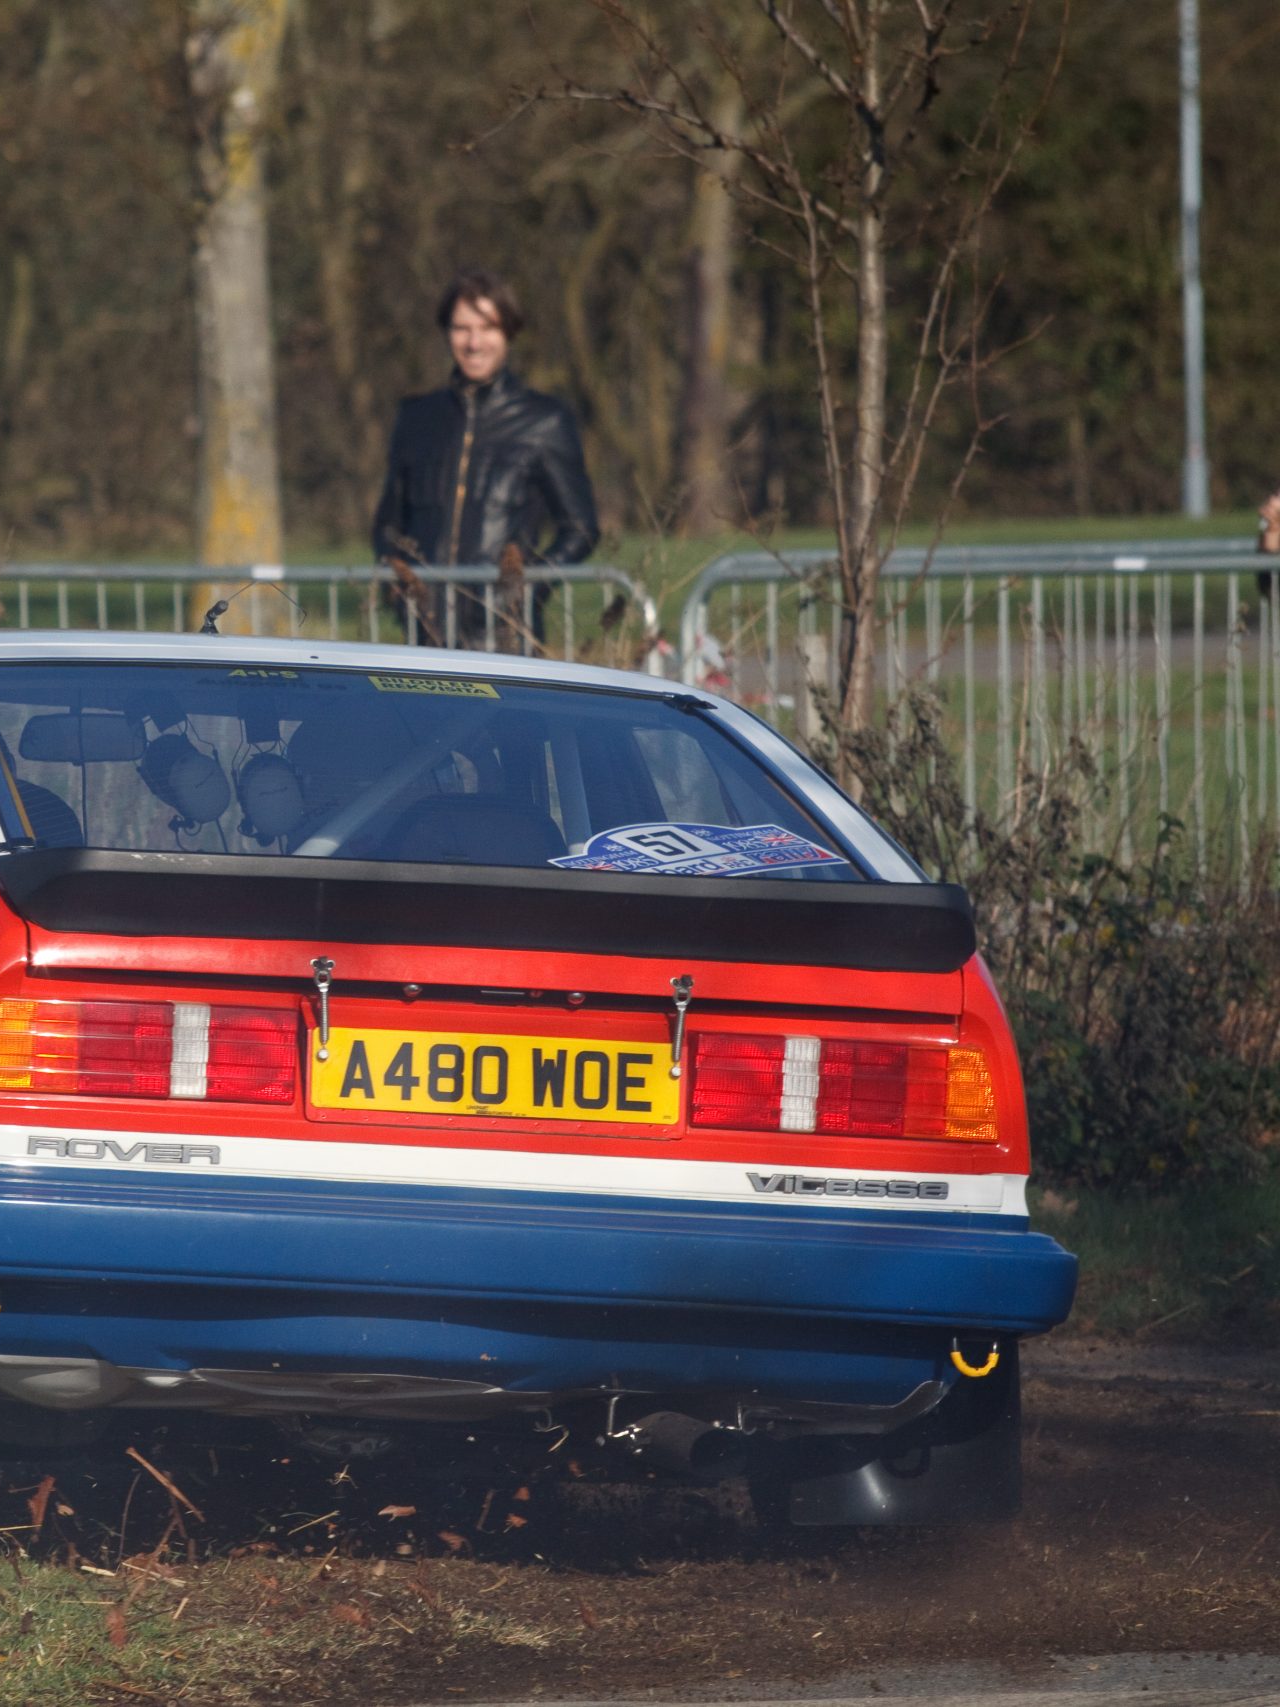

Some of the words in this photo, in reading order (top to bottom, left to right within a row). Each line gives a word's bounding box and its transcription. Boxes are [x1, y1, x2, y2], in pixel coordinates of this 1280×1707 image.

[377, 677, 476, 688] BILDELER
[381, 683, 489, 695] REKVISITA
[625, 830, 703, 856] 57
[611, 855, 660, 871] 1985
[339, 1039, 508, 1105] A480
[532, 1047, 654, 1112] WOE
[27, 1135, 221, 1165] ROVER
[745, 1171, 950, 1200] Vitesse
